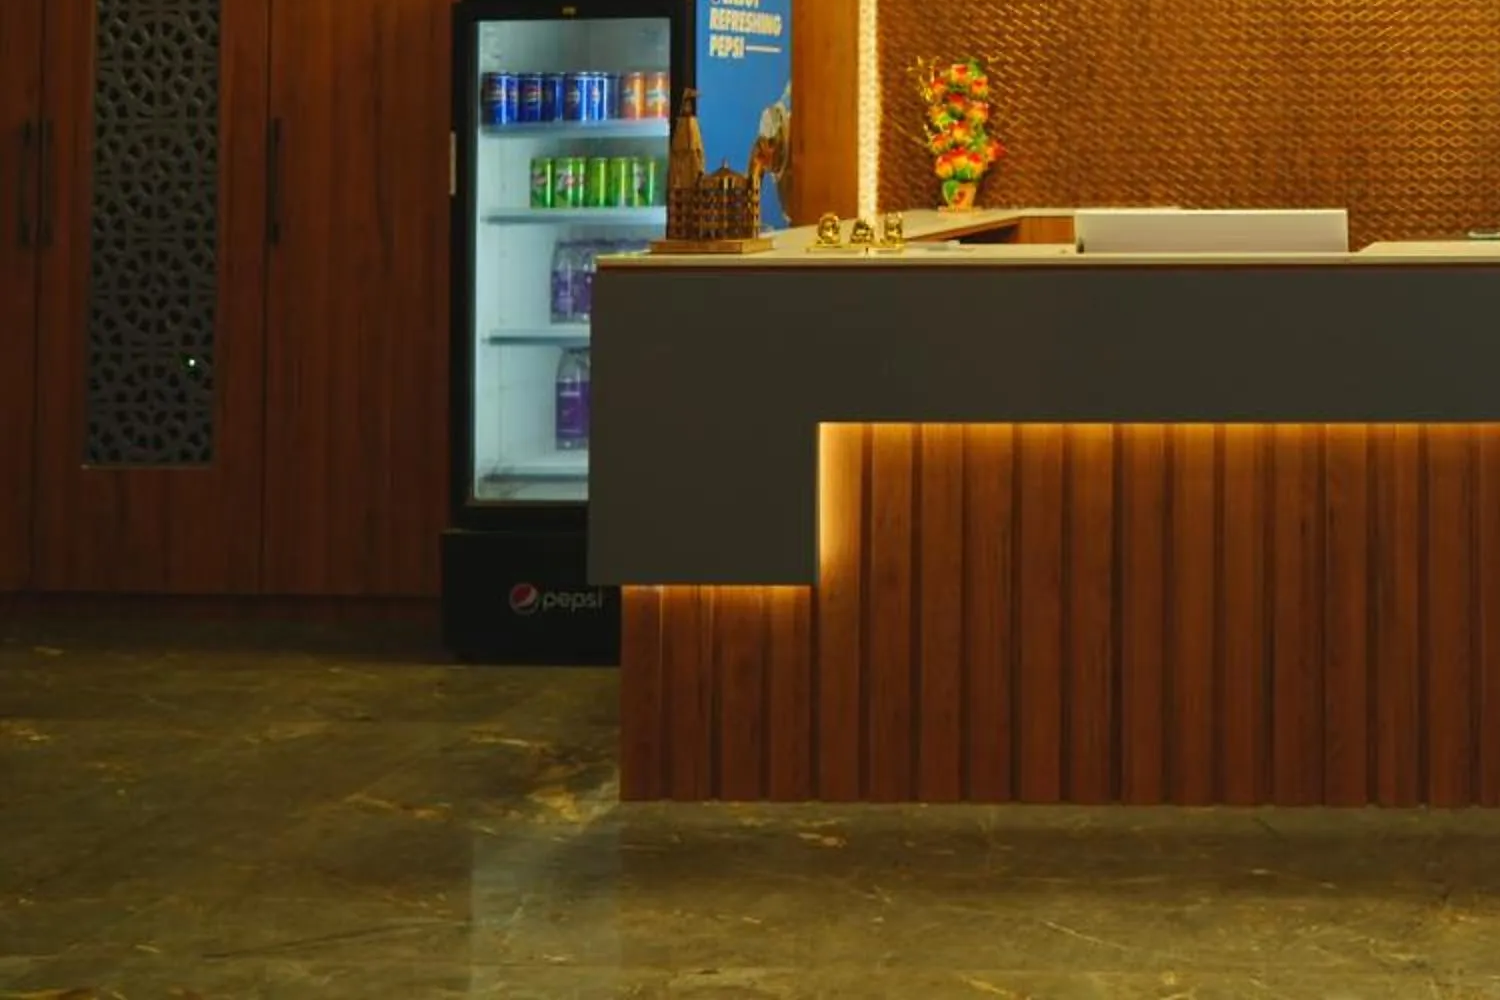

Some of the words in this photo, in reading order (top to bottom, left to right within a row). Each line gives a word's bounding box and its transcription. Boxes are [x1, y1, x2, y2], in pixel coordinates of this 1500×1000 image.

[709, 7, 782, 37] REFRESHING
[709, 34, 745, 59] PEPSI
[543, 587, 602, 613] pepsi
